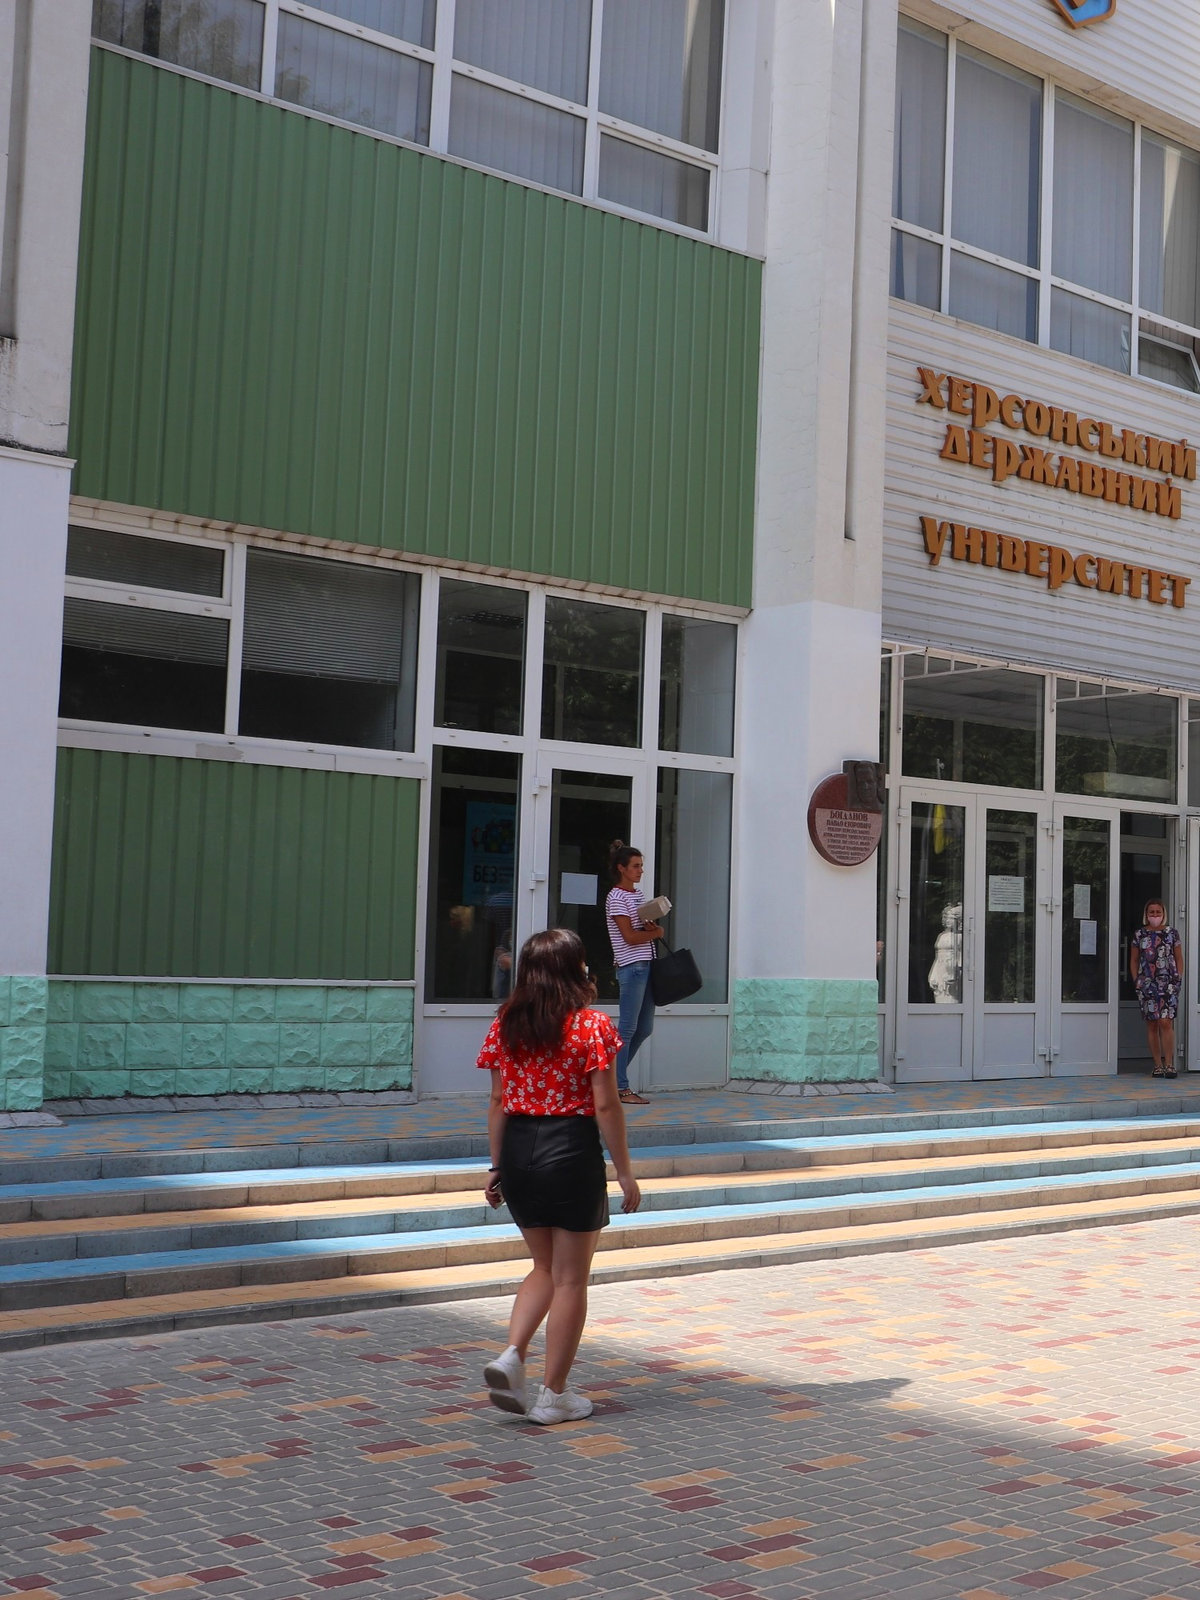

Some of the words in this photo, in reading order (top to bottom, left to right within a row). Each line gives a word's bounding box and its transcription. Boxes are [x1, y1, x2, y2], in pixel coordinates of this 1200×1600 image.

[916, 366, 1197, 480] ХЕРСОНСЬКИЙ
[939, 424, 1182, 519] ДЕРЖАВНИЙ
[919, 516, 1191, 608] УНІВЕРСИТЕТ
